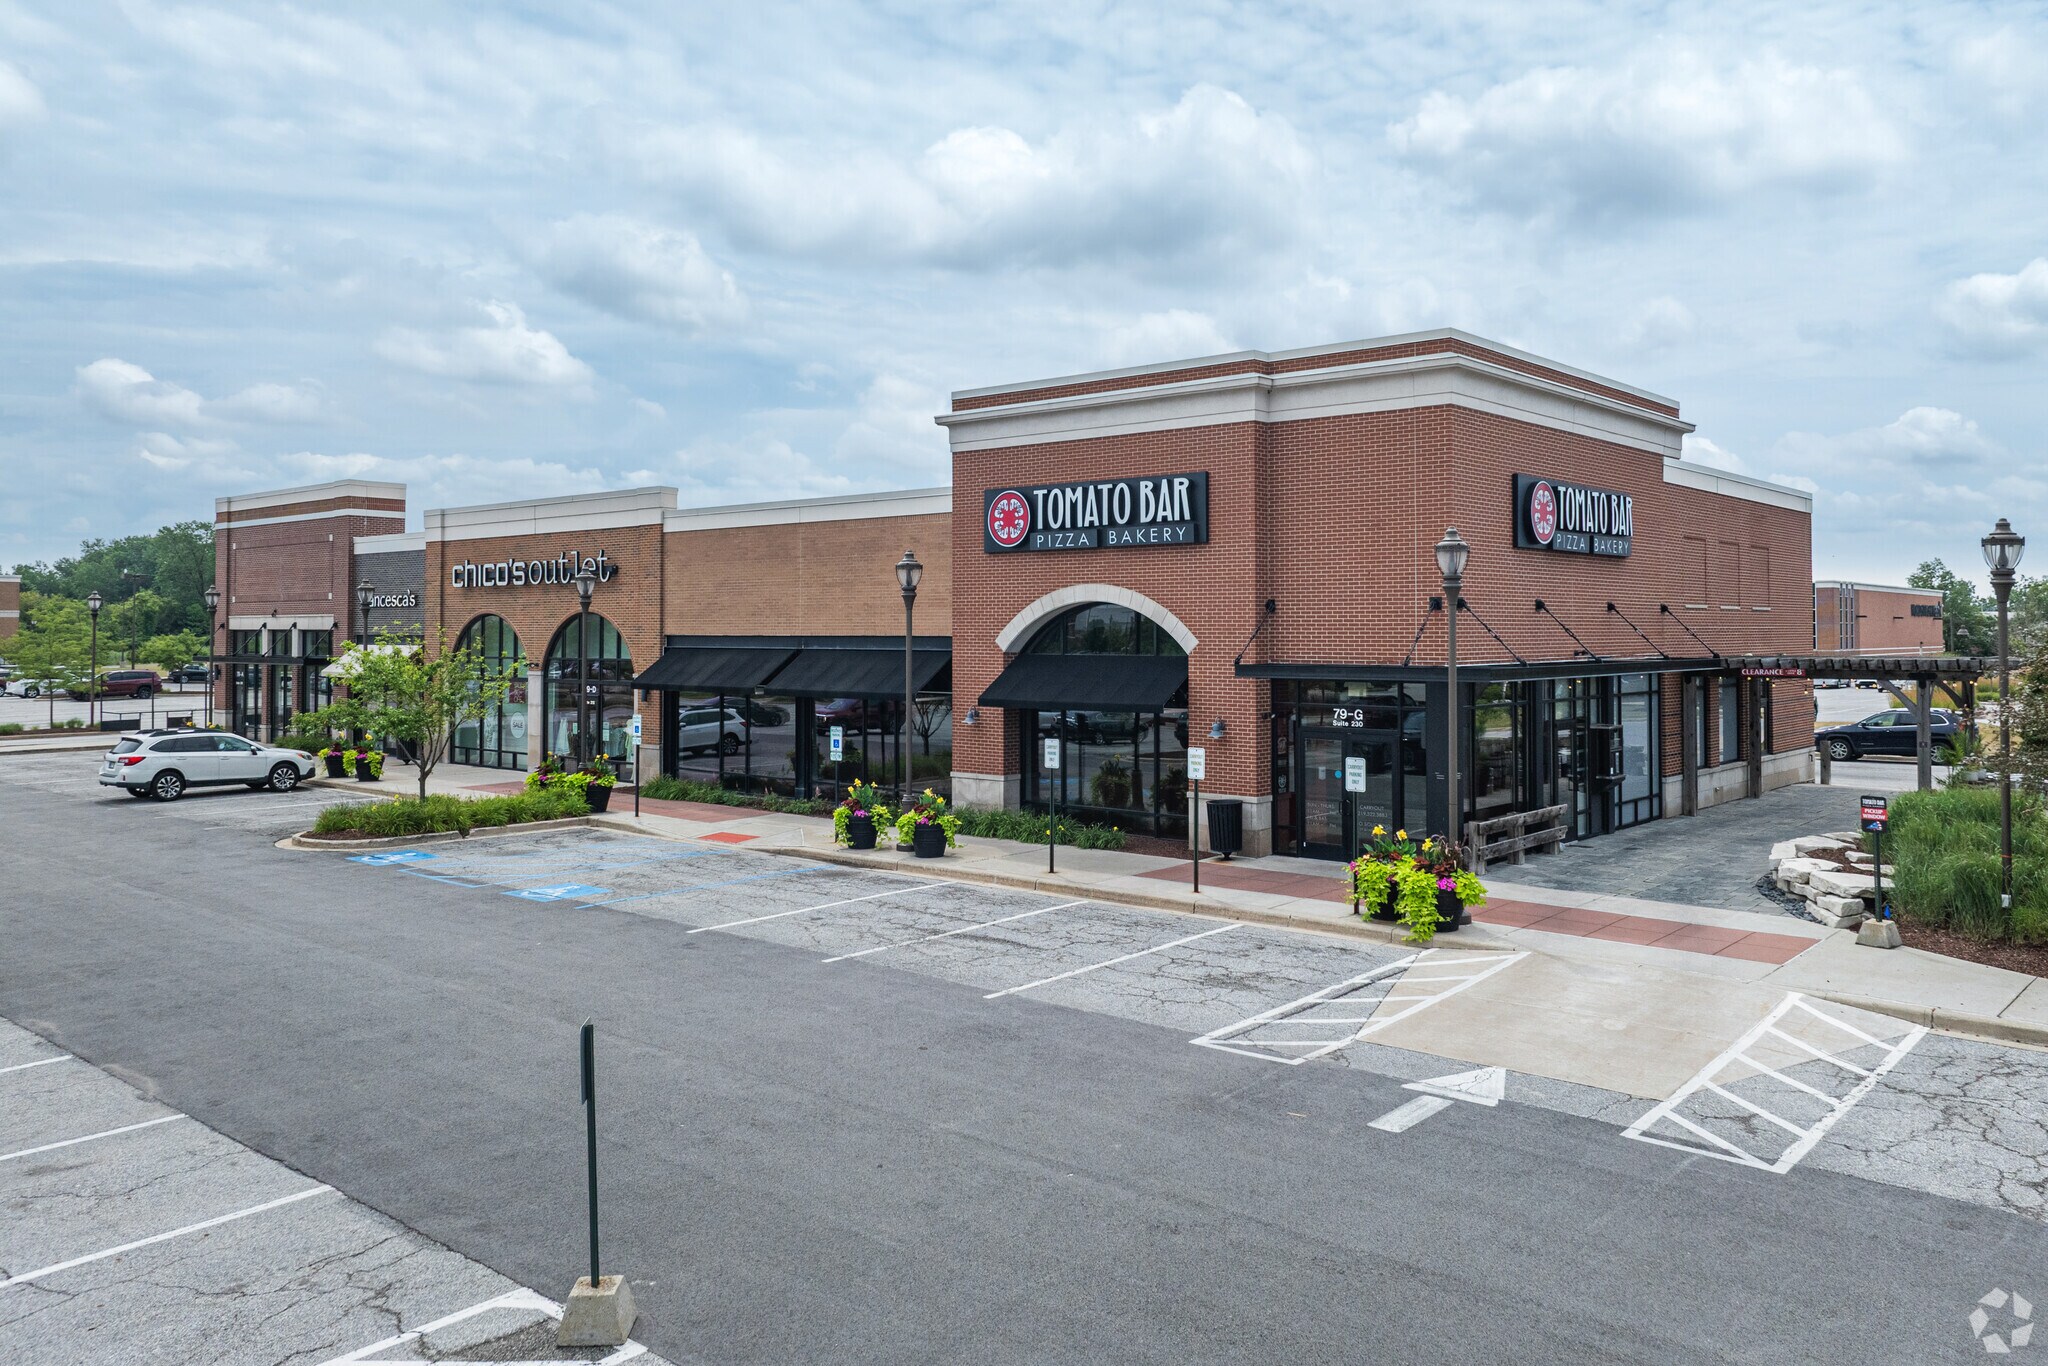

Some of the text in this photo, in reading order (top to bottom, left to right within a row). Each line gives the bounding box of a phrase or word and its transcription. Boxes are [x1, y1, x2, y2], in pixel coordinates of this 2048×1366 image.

[1033, 477, 1191, 529] TOMATO BAR
[1557, 486, 1633, 537] TOMATO BAR
[1037, 527, 1186, 548] PIZZA BAKERY
[1556, 534, 1629, 554] PIZZA BAKERY
[452, 559, 526, 588] chico's
[369, 589, 416, 608] ancesca's
[1741, 668, 1784, 676] CLEARANCE
[1333, 708, 1364, 720] 79-G
[512, 721, 524, 729] SALE
